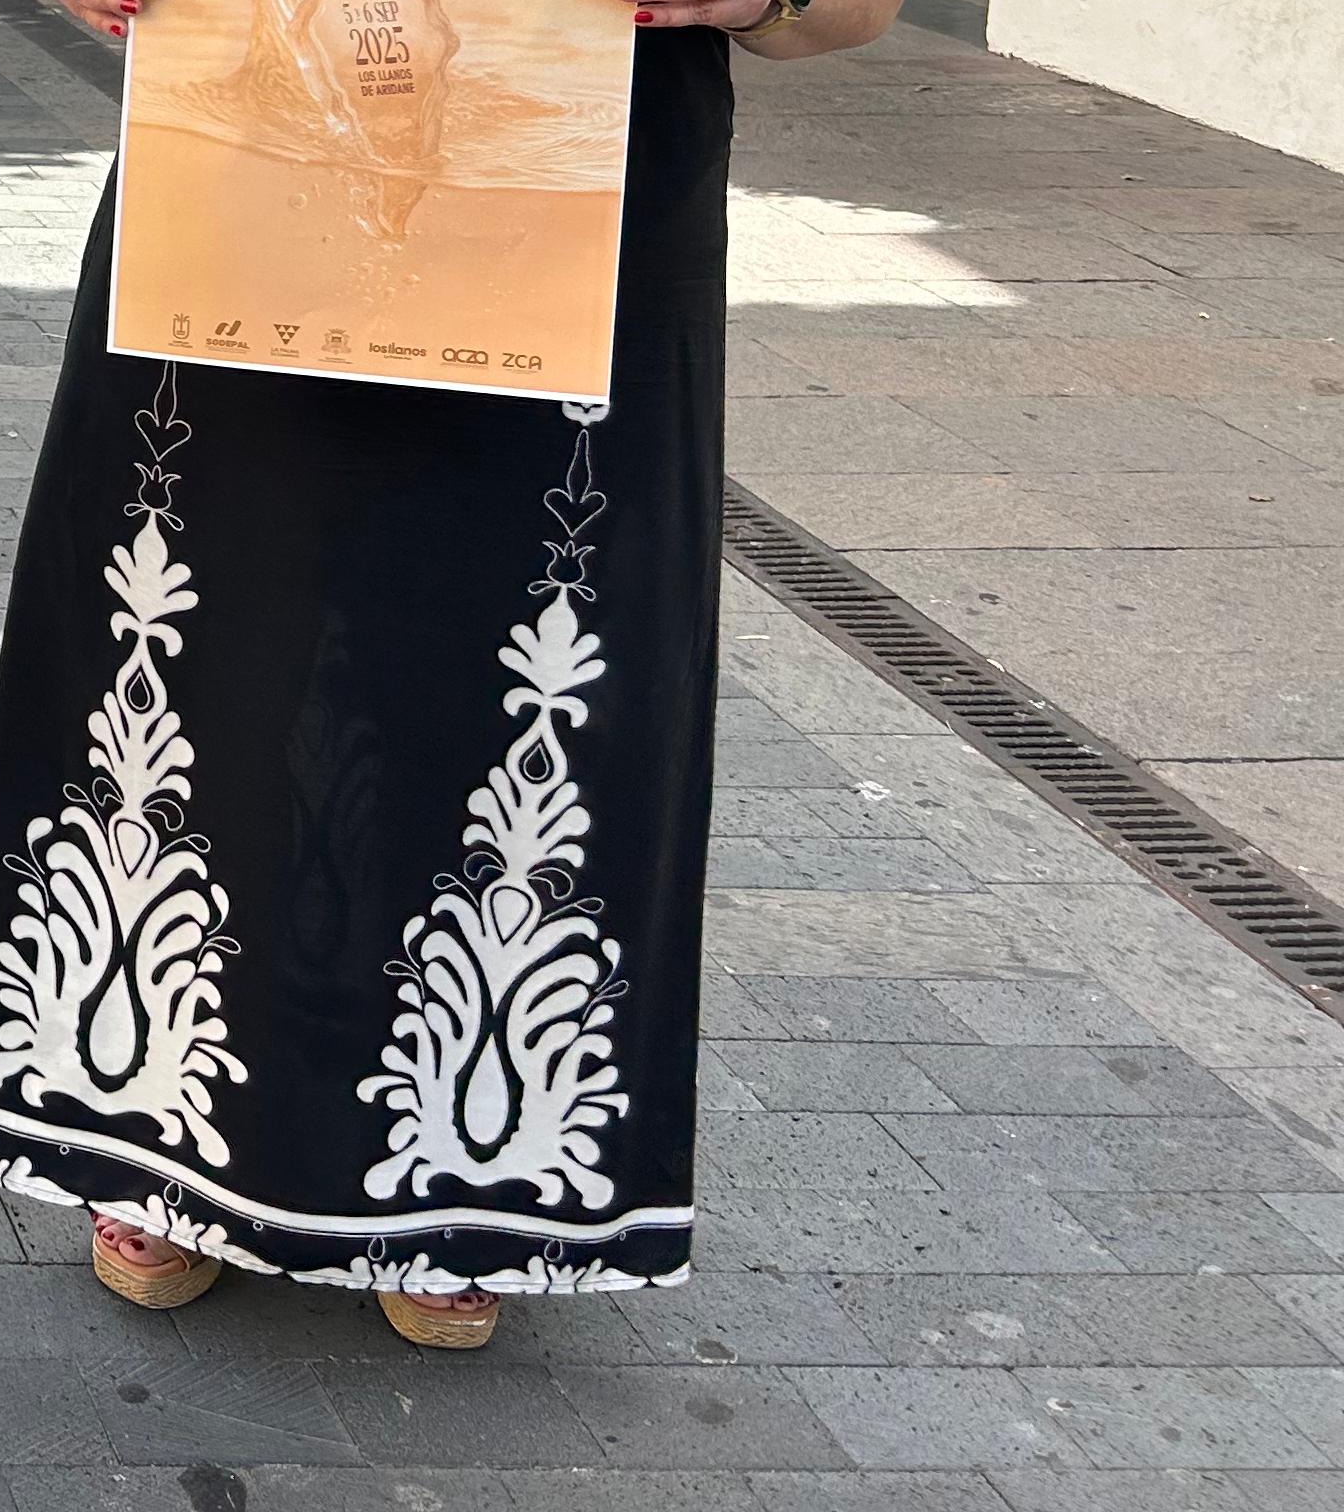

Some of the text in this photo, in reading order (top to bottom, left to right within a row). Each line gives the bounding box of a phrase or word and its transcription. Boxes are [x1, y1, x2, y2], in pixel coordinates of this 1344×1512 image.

[342, 3, 354, 25] 5
[362, 2, 373, 24] 6
[373, 0, 399, 23] SEP
[349, 25, 410, 66] 2025
[357, 68, 414, 83] LOS LLANOS
[360, 82, 416, 97] DE ARIDANE
[501, 352, 543, 371] ZCA
